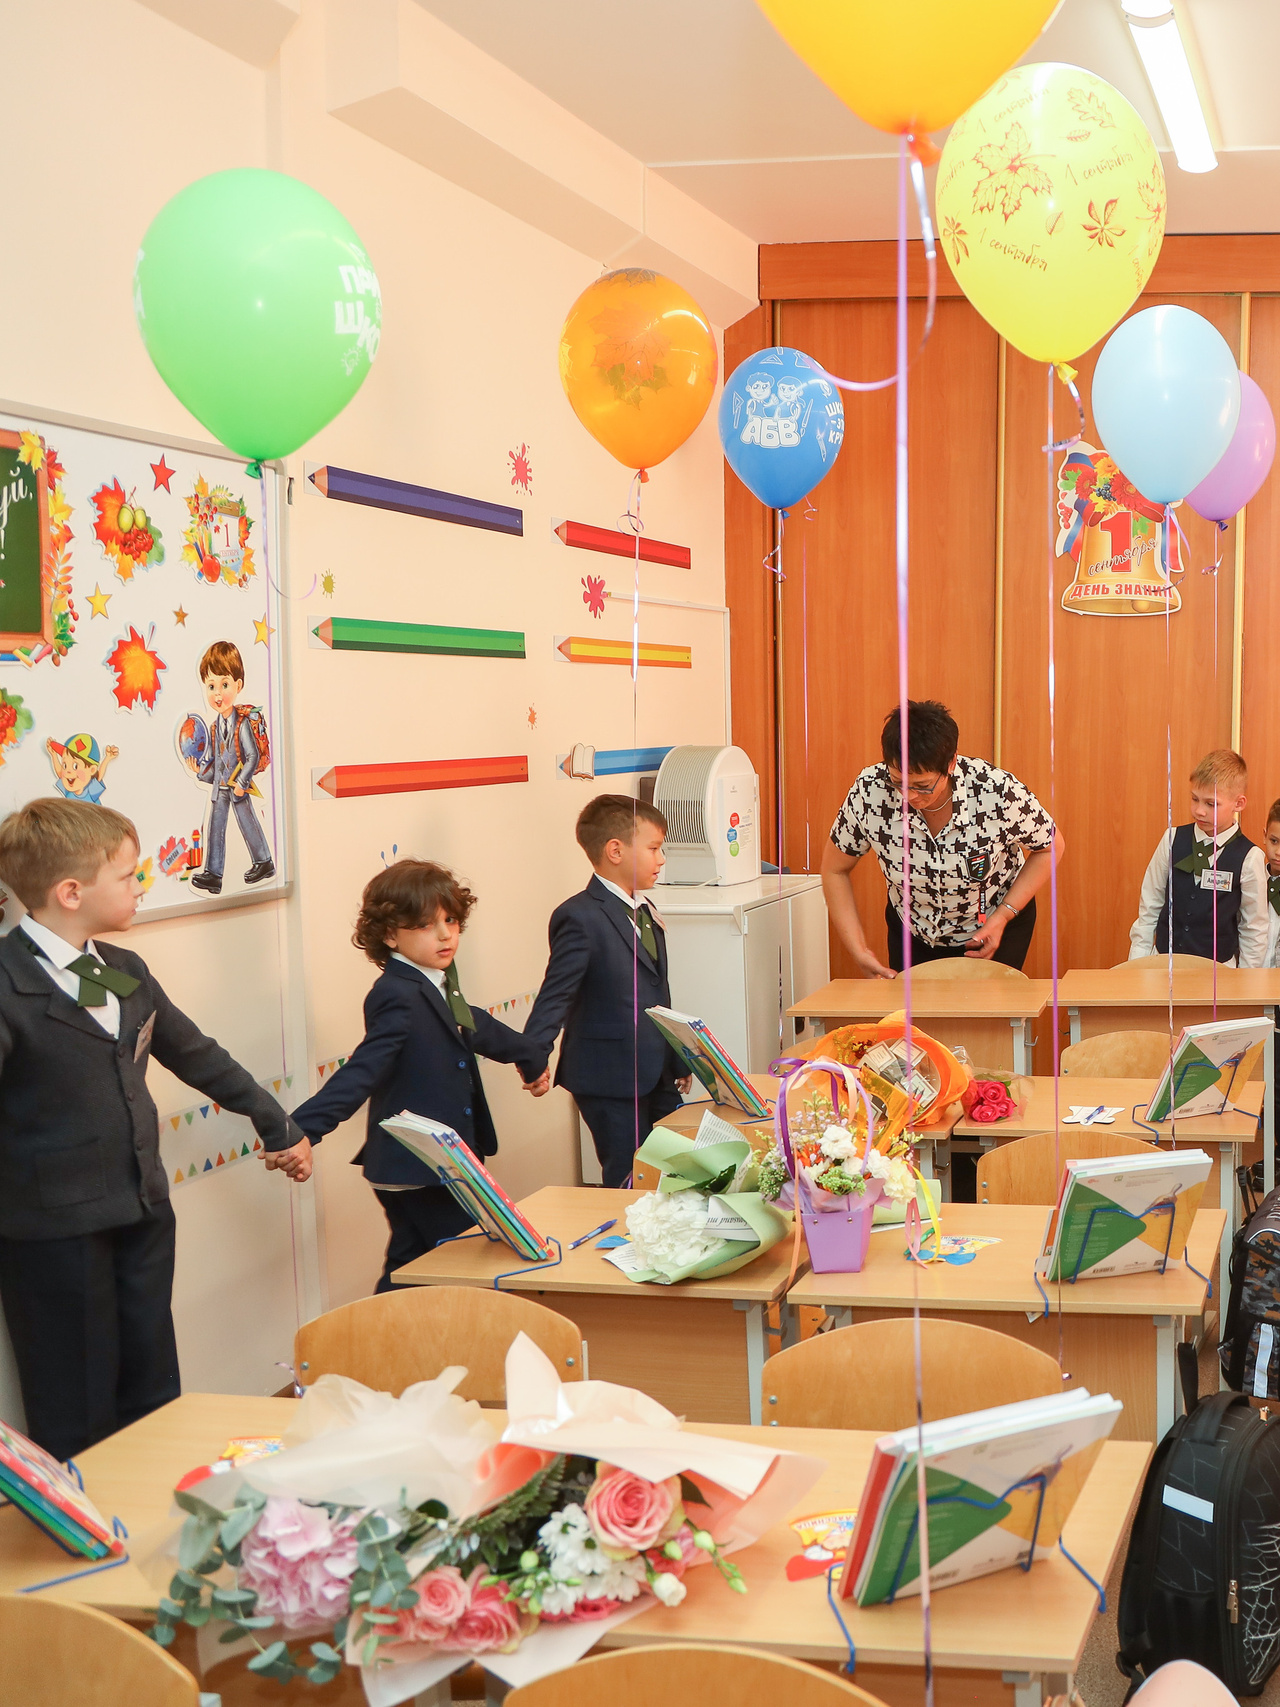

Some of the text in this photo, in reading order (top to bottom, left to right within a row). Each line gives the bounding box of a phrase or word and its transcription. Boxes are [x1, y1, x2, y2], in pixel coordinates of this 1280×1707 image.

[1082, 145, 1135, 180] сентября
[989, 238, 1049, 272] сентября
[740, 416, 801, 449] АБВ
[1087, 536, 1159, 577] сентября
[1100, 511, 1132, 573] 1
[1069, 583, 1110, 600] ДЕНЬ
